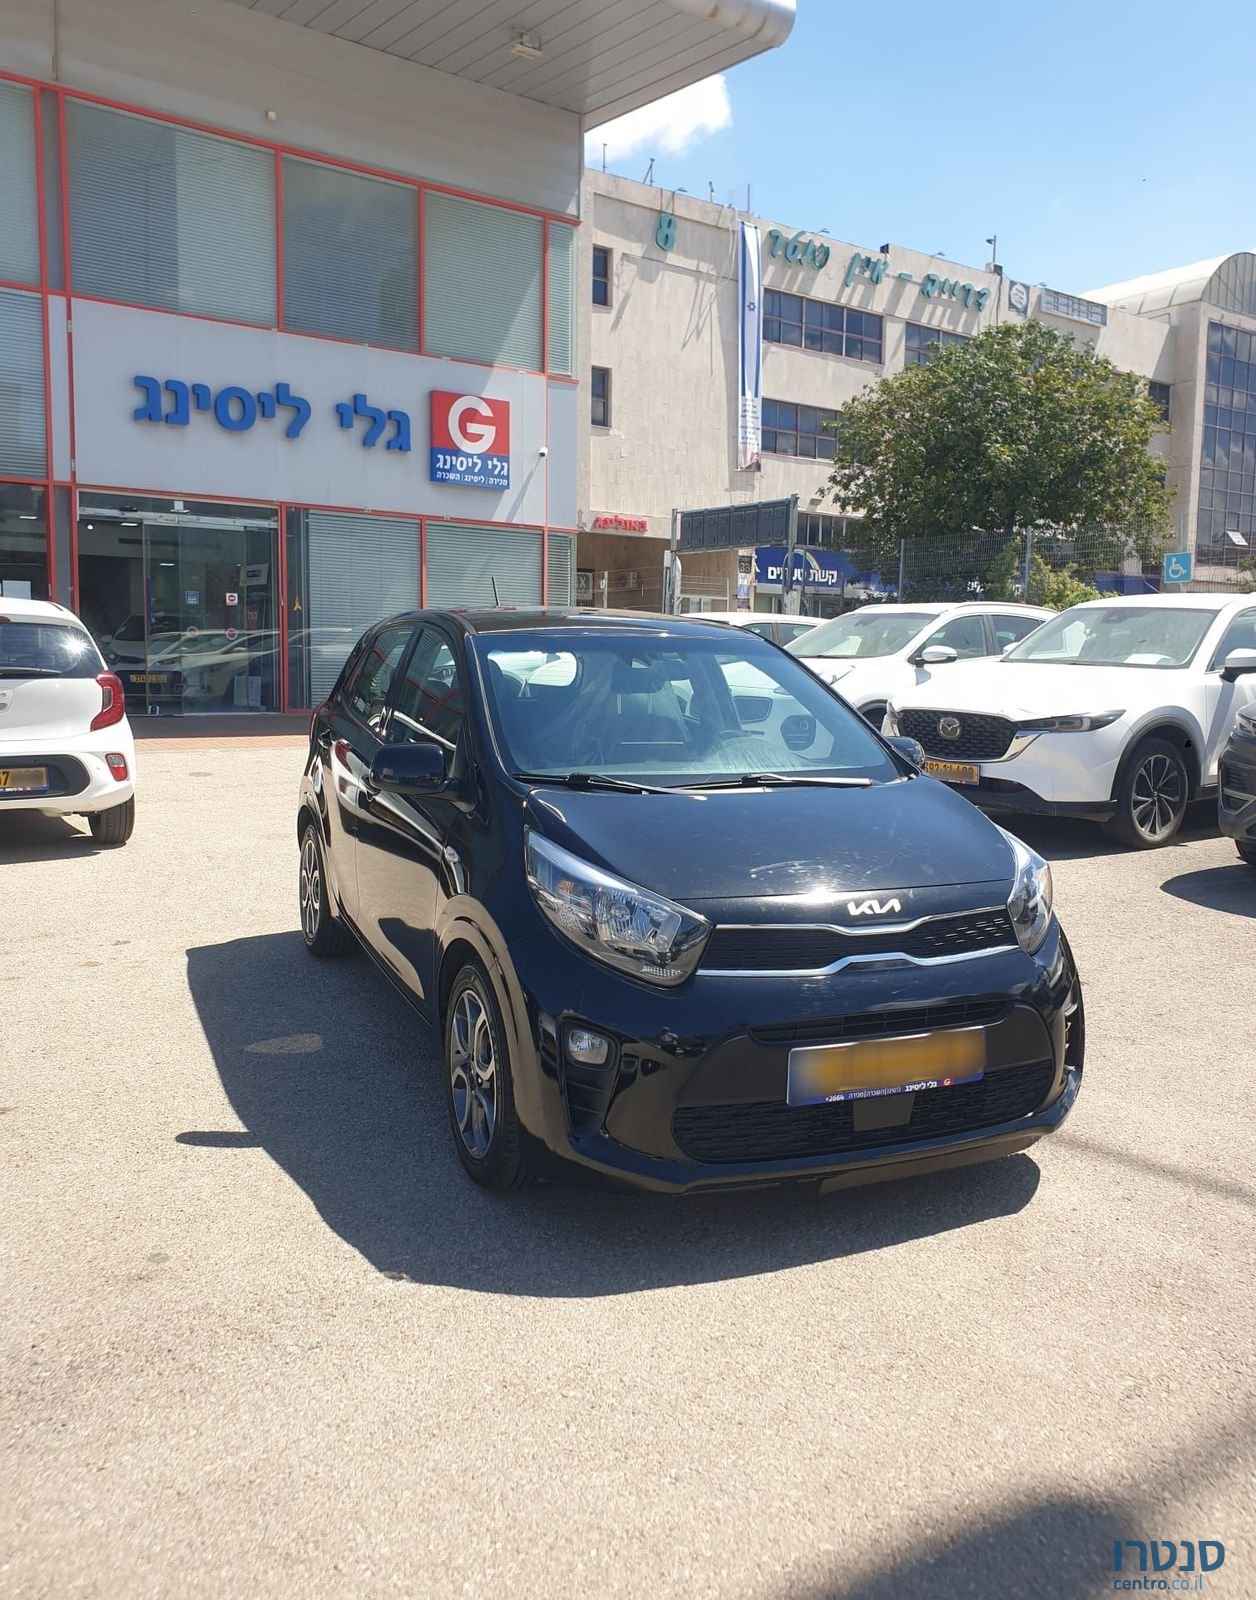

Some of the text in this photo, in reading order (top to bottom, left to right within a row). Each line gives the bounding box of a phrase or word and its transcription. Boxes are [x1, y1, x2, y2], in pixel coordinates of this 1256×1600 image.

[656, 213, 677, 252] 8
[768, 229, 830, 271] סנטר
[844, 253, 889, 288] אין
[133, 375, 412, 452] גלי ליסינג
[448, 395, 497, 455] G
[436, 454, 509, 476] גלי ליסינג
[809, 569, 838, 585] קשת
[847, 898, 902, 916] KIA
